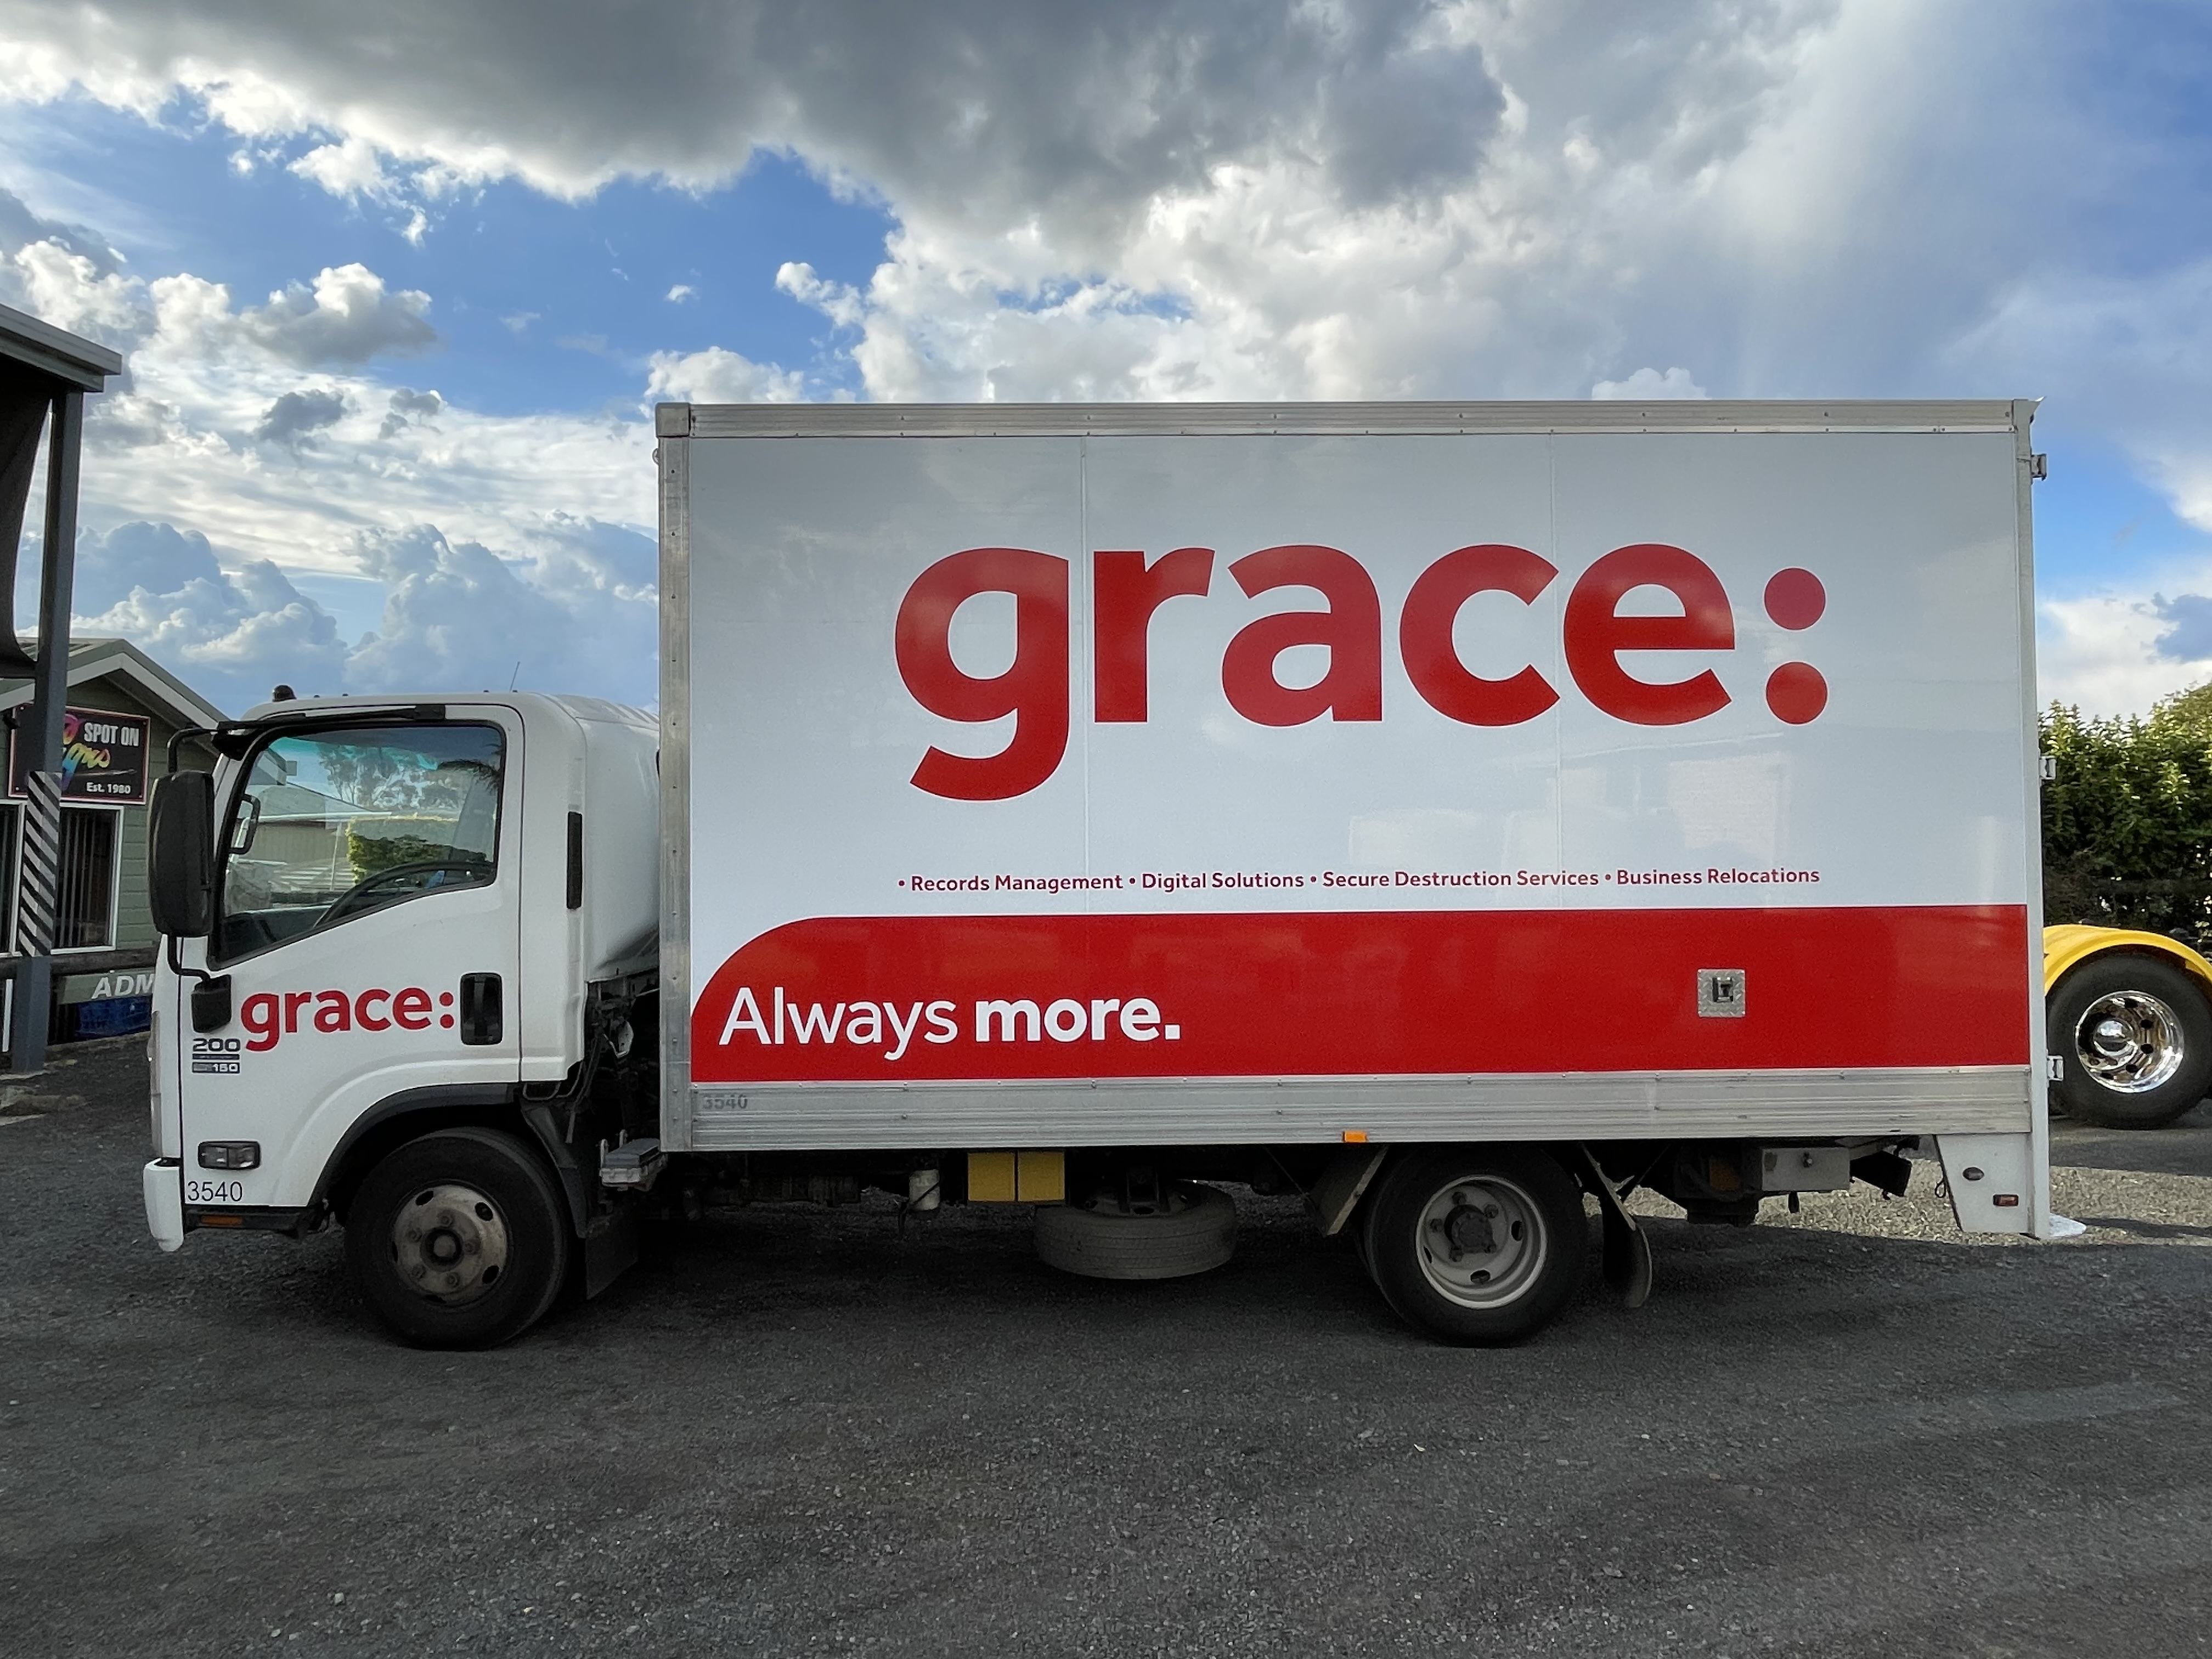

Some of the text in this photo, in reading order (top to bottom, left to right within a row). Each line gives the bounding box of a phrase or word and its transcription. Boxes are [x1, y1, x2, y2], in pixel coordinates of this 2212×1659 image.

[896, 544, 1827, 801] grace:
[83, 723, 139, 746] SPOT ON
[87, 782, 131, 794] Est. 1980
[911, 868, 1820, 895] Records Management Digital Solutions Secure Destruction Services Business Relocations
[240, 987, 454, 1052] grace:
[719, 986, 1181, 1060] Always more.
[193, 1038, 240, 1052] 200
[702, 1094, 748, 1109] 3540
[187, 1181, 242, 1201] 3540
